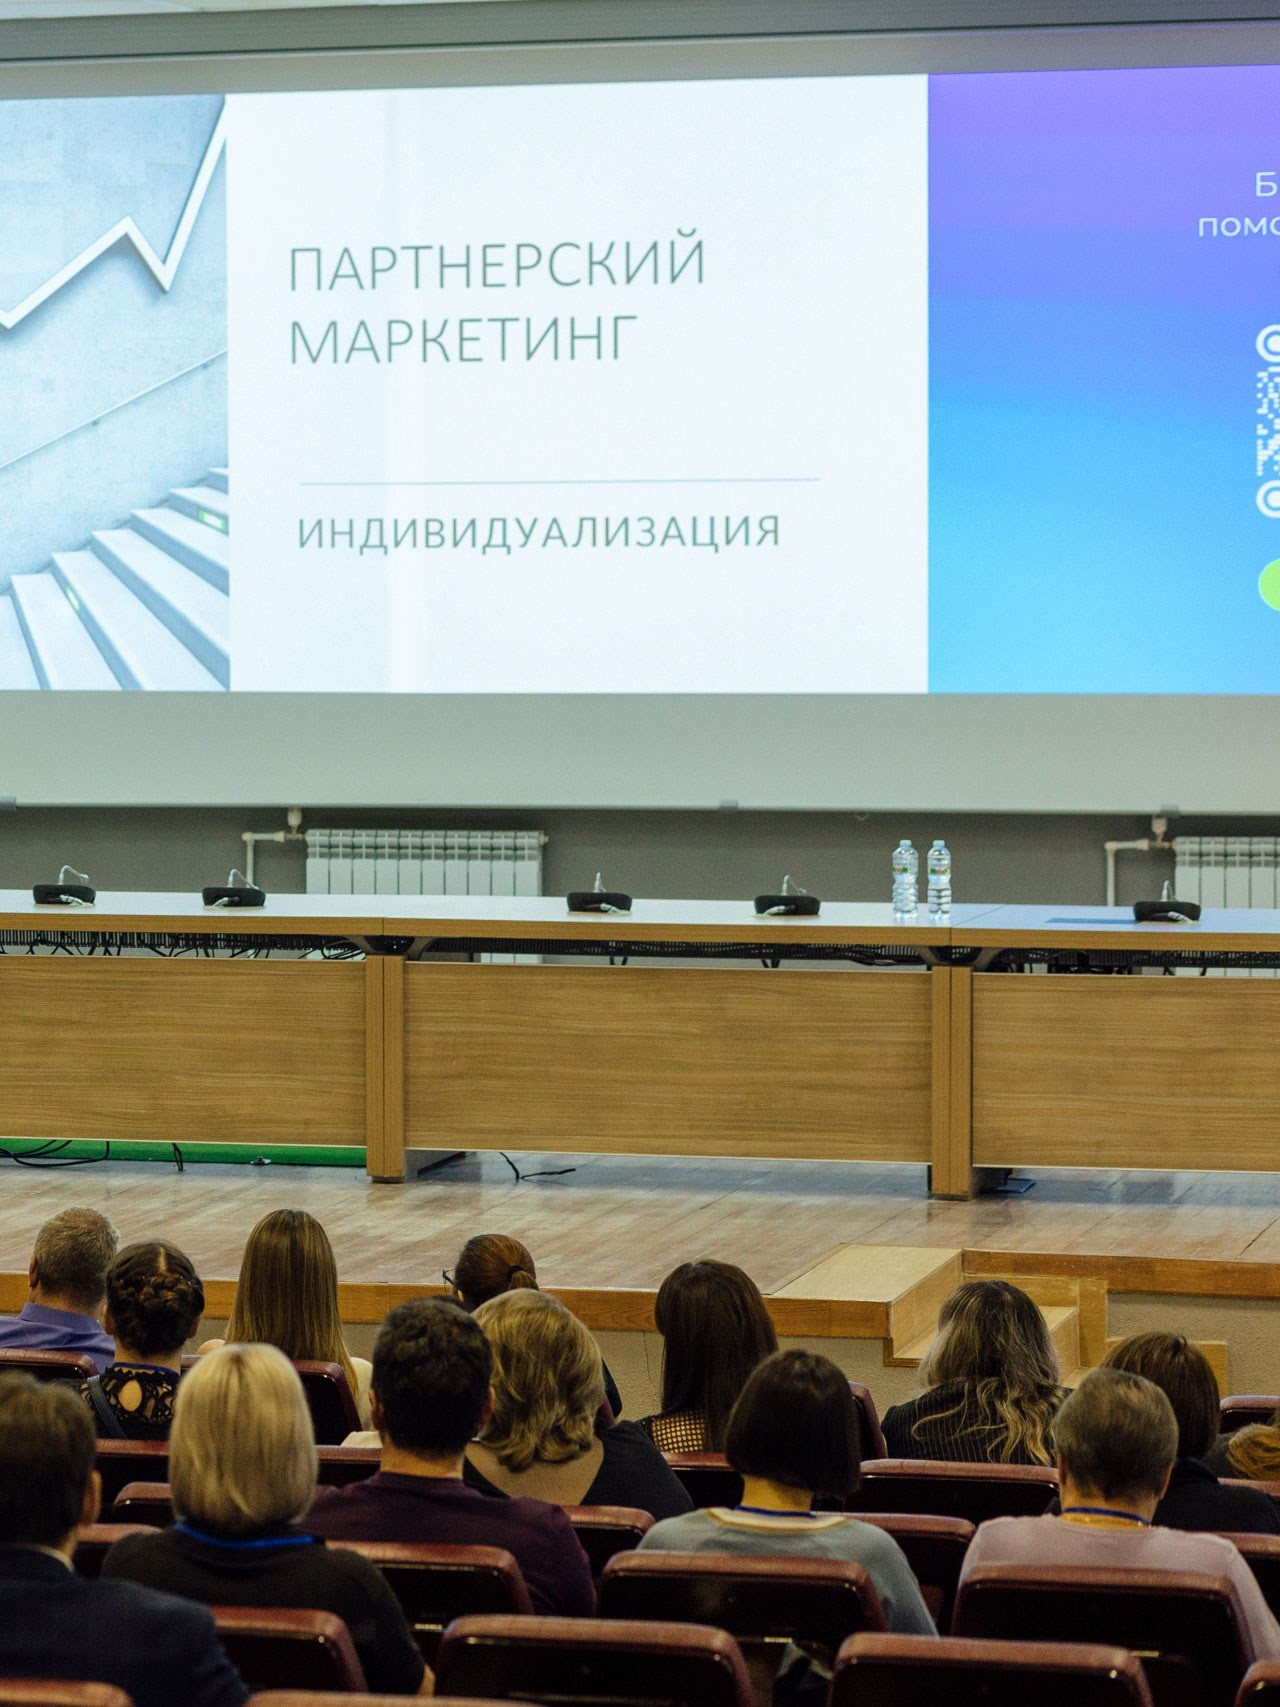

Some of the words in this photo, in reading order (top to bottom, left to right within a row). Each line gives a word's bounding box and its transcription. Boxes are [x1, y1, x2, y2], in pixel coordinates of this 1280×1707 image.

[290, 228, 704, 292] ПАРТНЕРСКИЙ
[291, 315, 638, 365] МАРКЕТИНГ
[298, 515, 780, 556] ИНДИВИДУАЛИЗАЦИЯ
